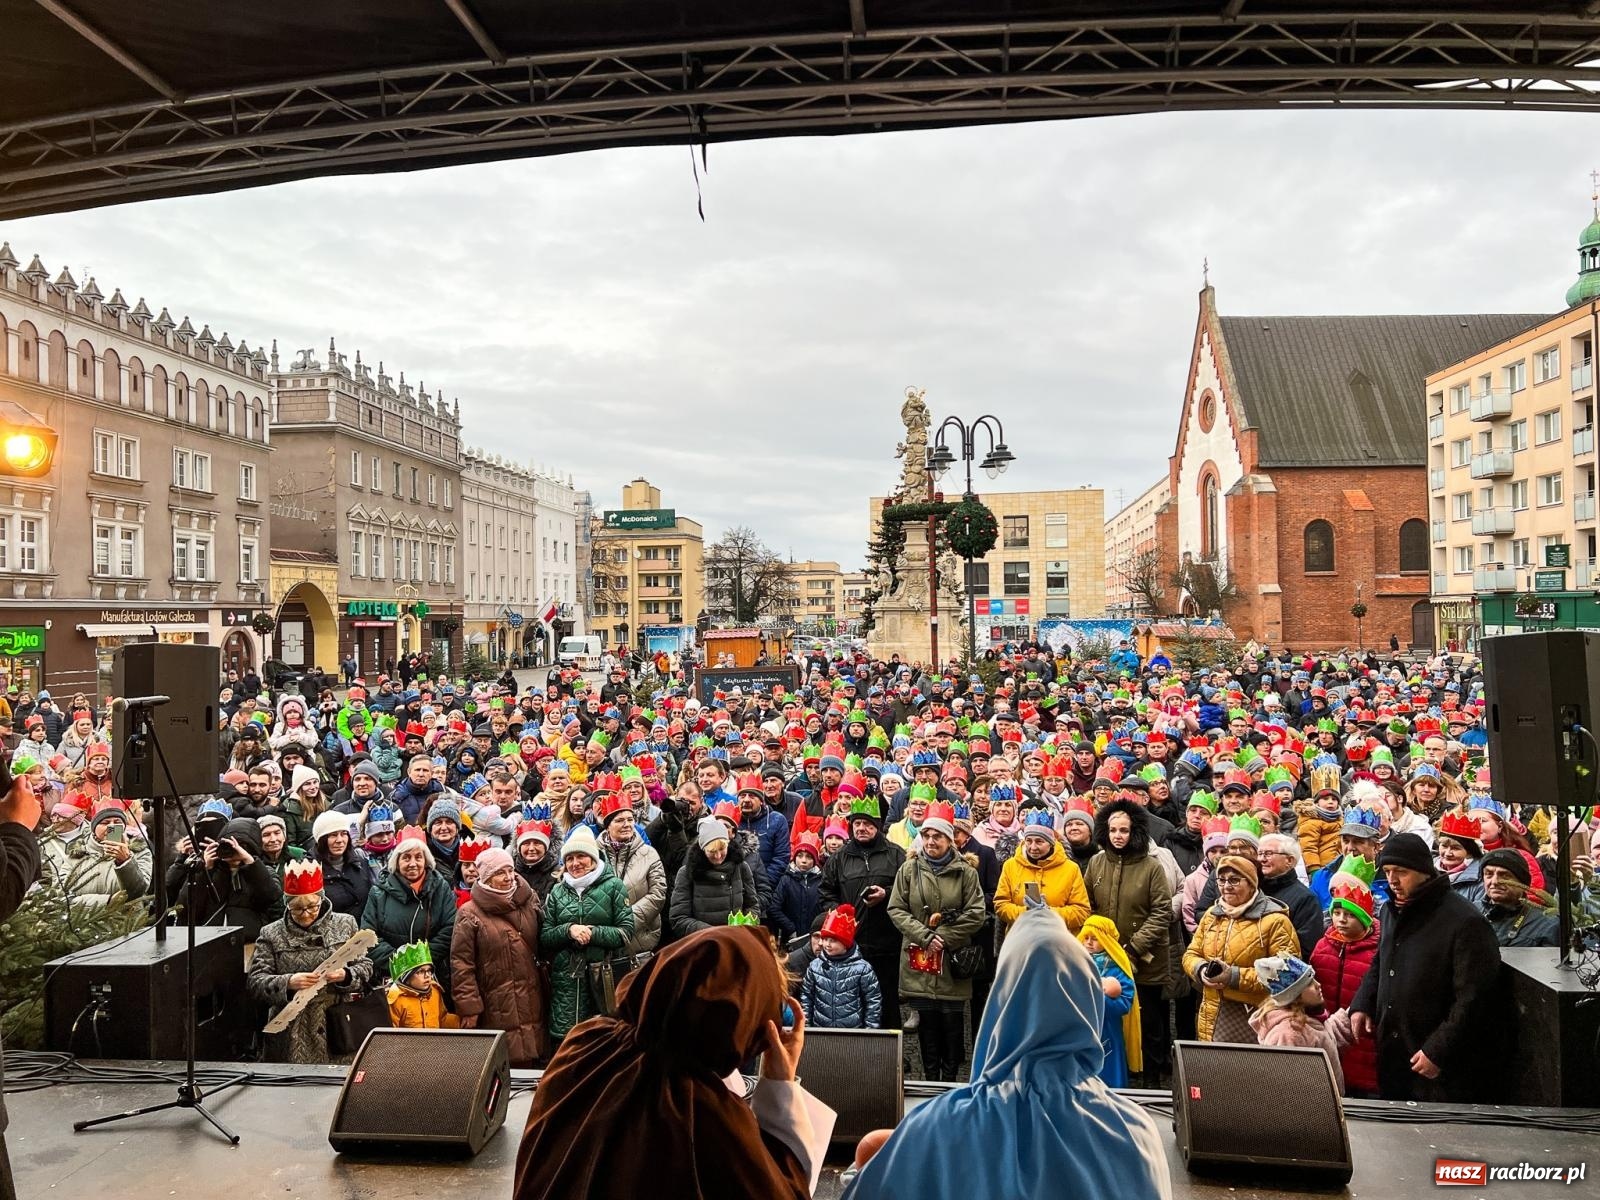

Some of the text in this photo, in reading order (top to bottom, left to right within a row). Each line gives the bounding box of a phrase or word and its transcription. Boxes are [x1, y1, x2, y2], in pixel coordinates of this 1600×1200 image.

[621, 515, 658, 523] McDonald's
[347, 601, 398, 616] APTEKA
[1440, 604, 1472, 619] STELLA
[101, 609, 145, 623] Manufaktura
[146, 610, 168, 623] Lodów
